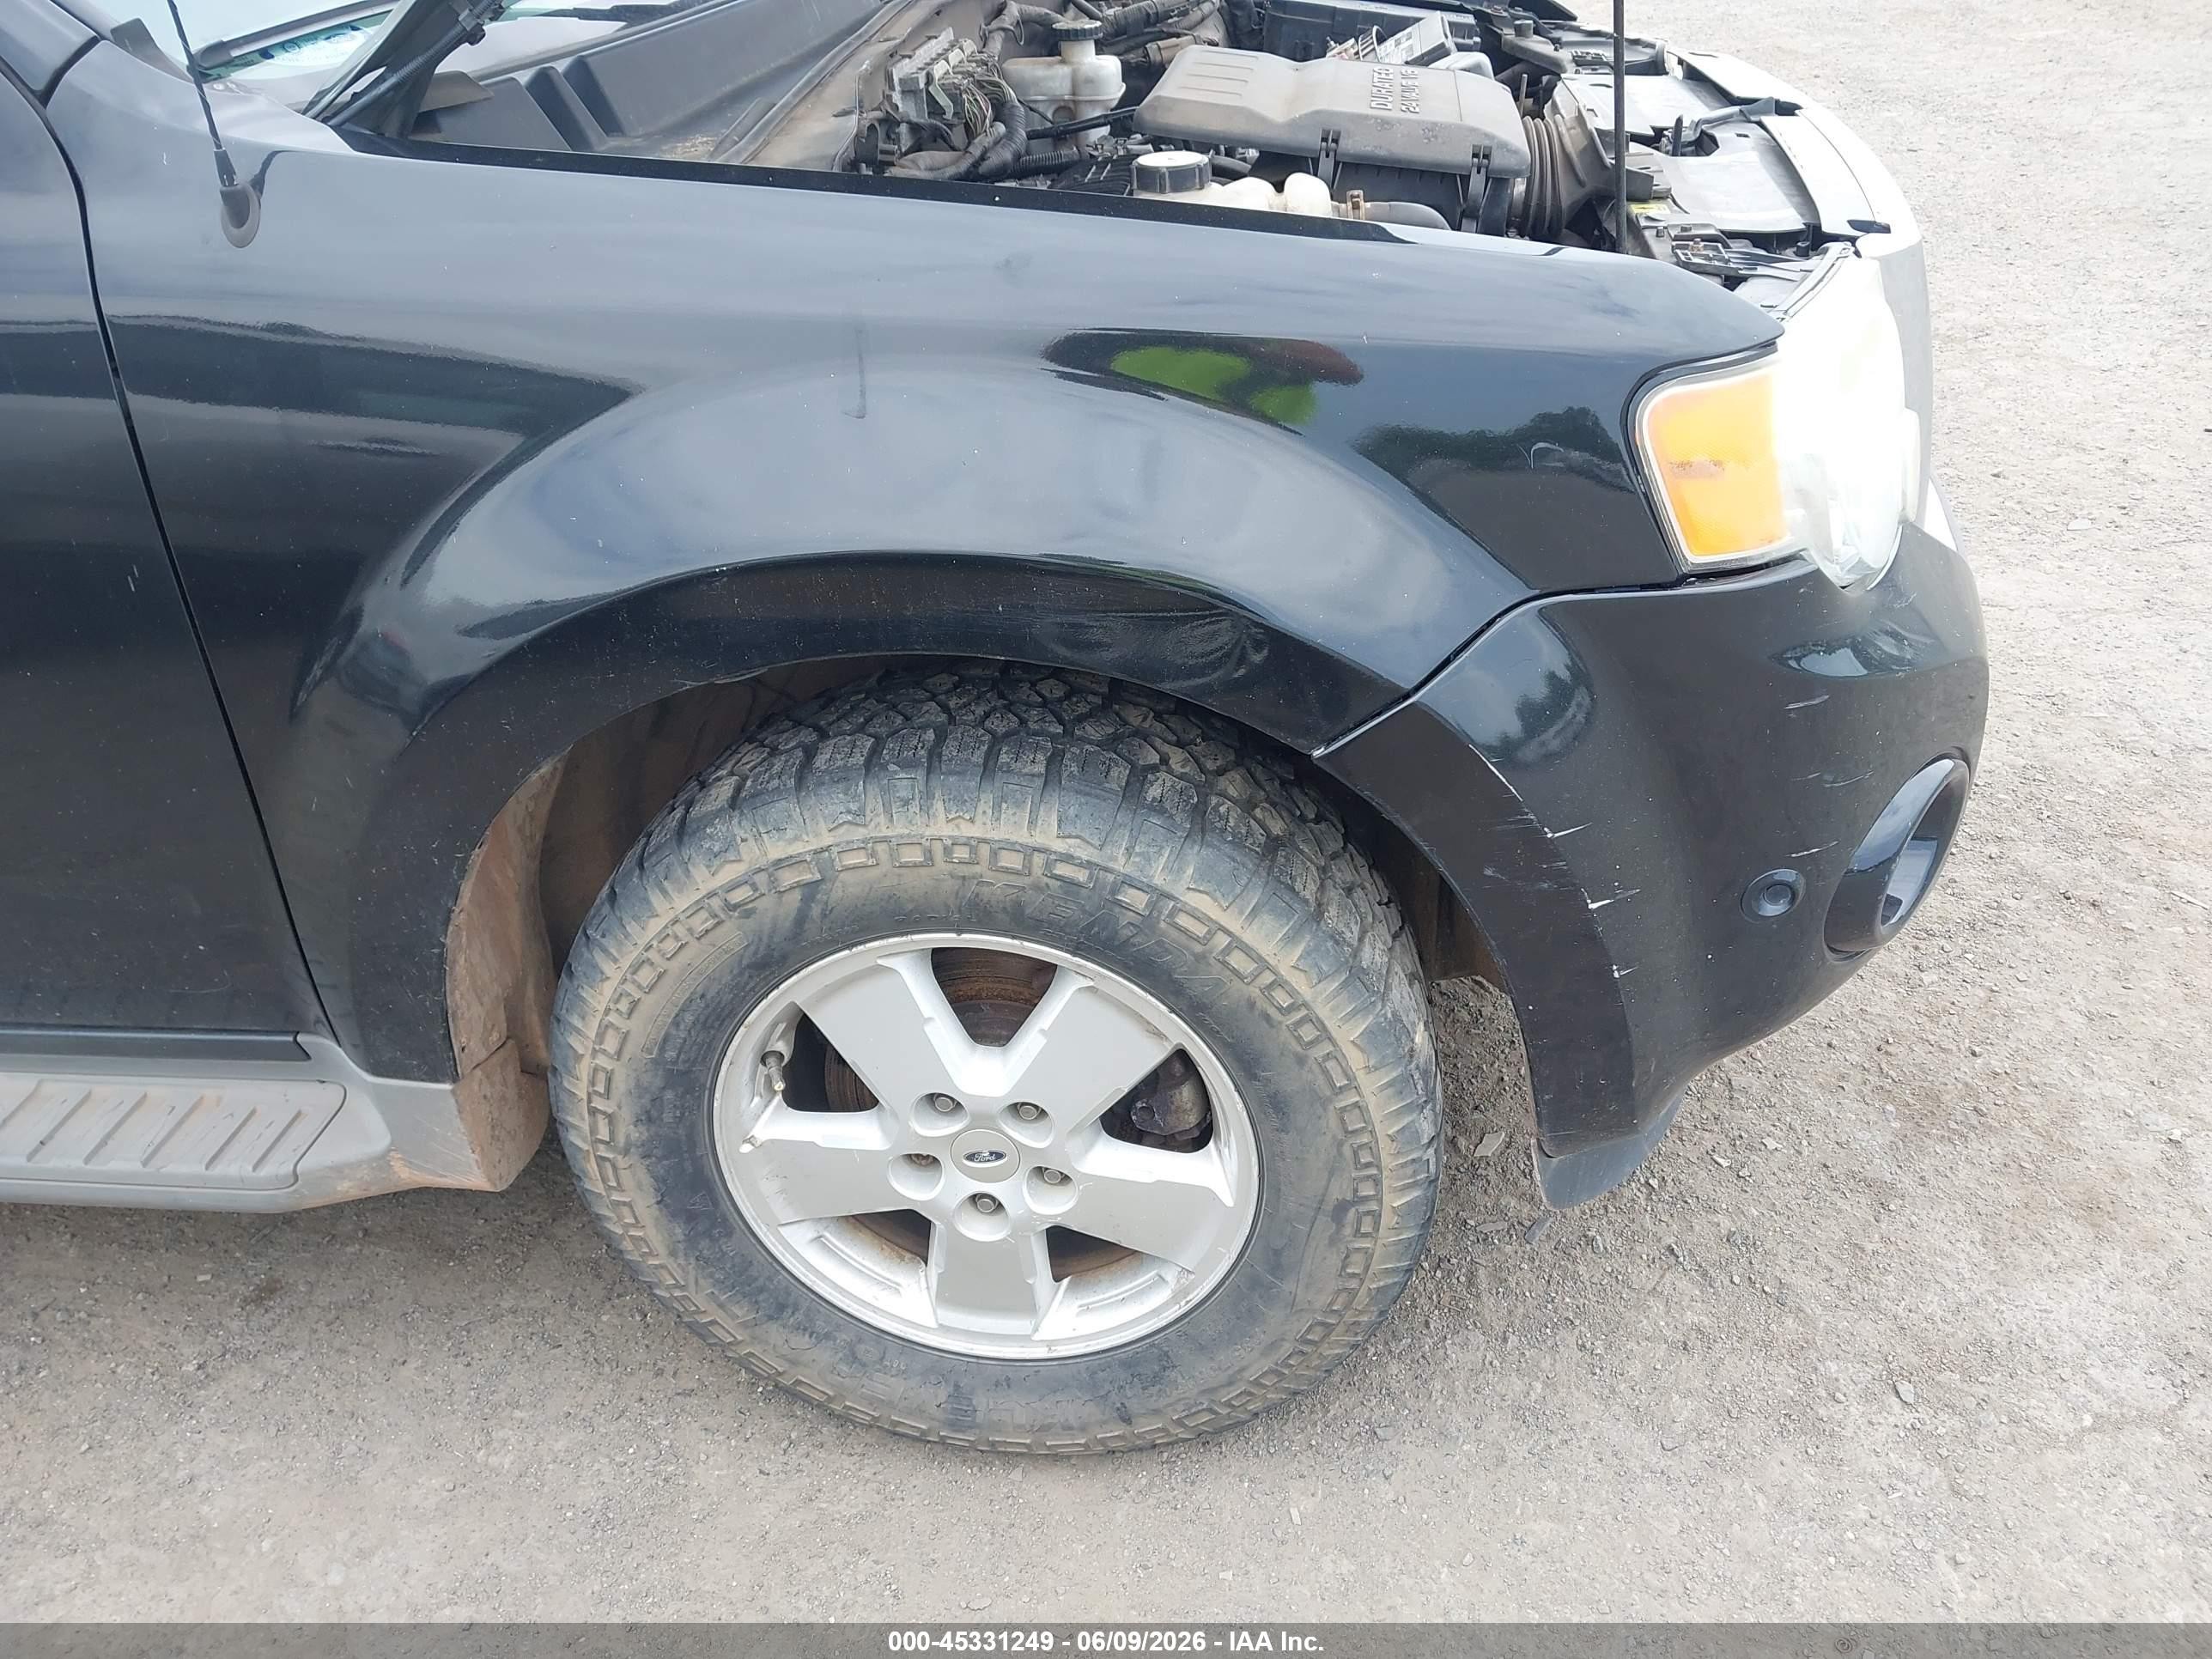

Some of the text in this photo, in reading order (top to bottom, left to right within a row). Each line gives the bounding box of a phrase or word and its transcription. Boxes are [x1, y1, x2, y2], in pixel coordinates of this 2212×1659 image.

[1370, 67, 1394, 112] DURATEC
[1400, 81, 1419, 102] VALVE
[955, 878, 1234, 1006] KENDA
